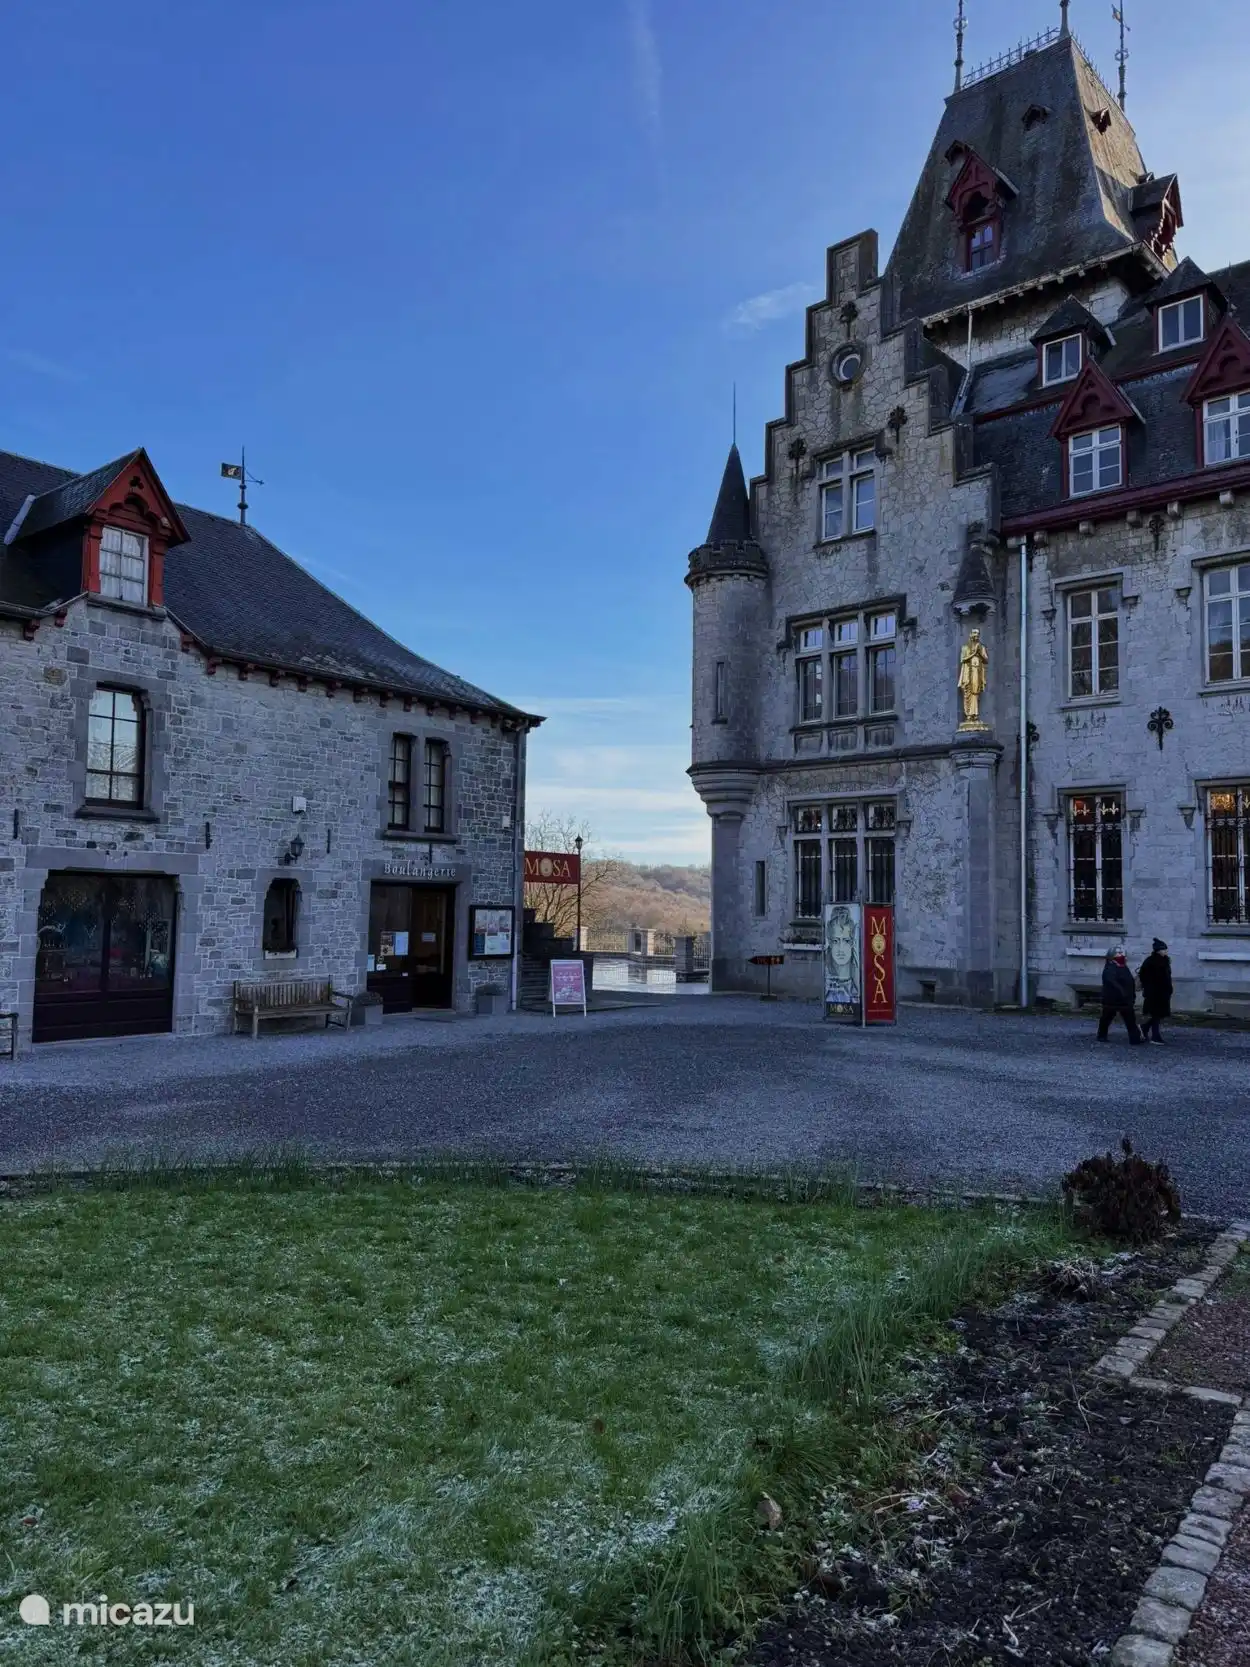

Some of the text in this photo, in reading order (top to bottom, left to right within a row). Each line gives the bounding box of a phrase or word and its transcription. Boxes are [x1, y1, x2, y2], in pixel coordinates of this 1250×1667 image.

[384, 859, 456, 880] Boulangerie
[524, 857, 572, 879] MOSA
[871, 916, 888, 1003] MOSA
[829, 1004, 854, 1014] MOSA
